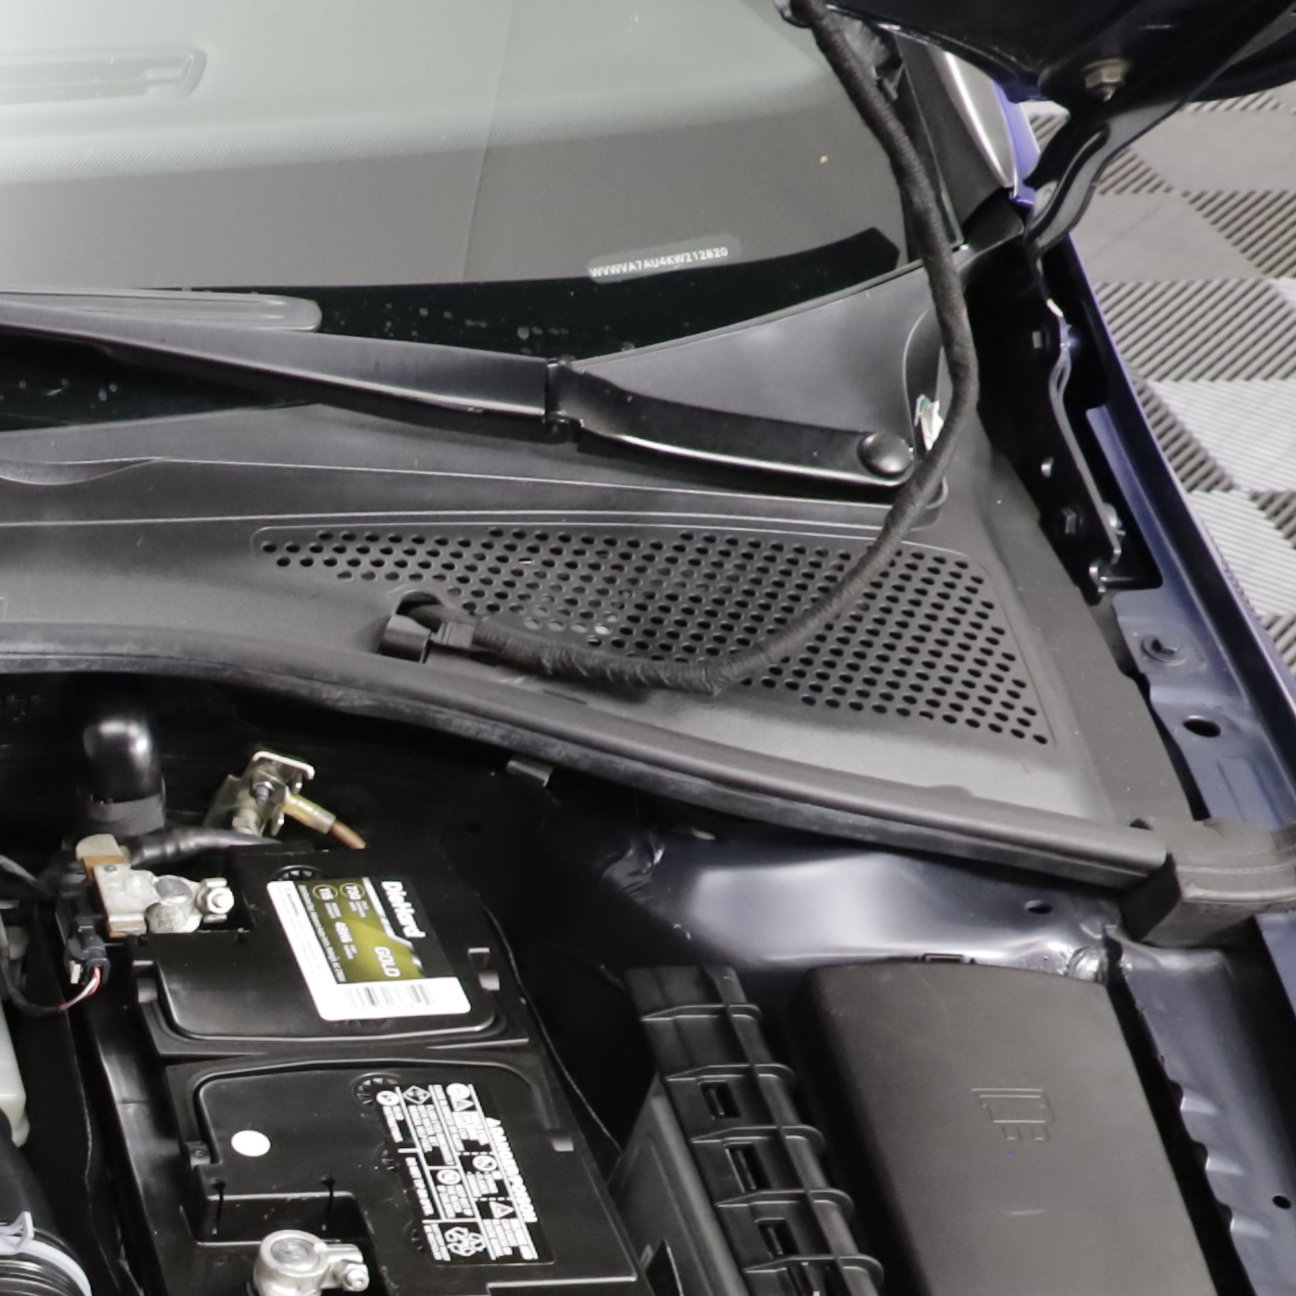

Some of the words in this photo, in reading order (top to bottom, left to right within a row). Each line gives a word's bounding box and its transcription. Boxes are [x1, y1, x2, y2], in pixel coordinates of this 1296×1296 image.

[589, 247, 729, 277] WVWVA7AU4KW212820
[381, 881, 426, 938] DieHard
[374, 946, 402, 978] GOLD
